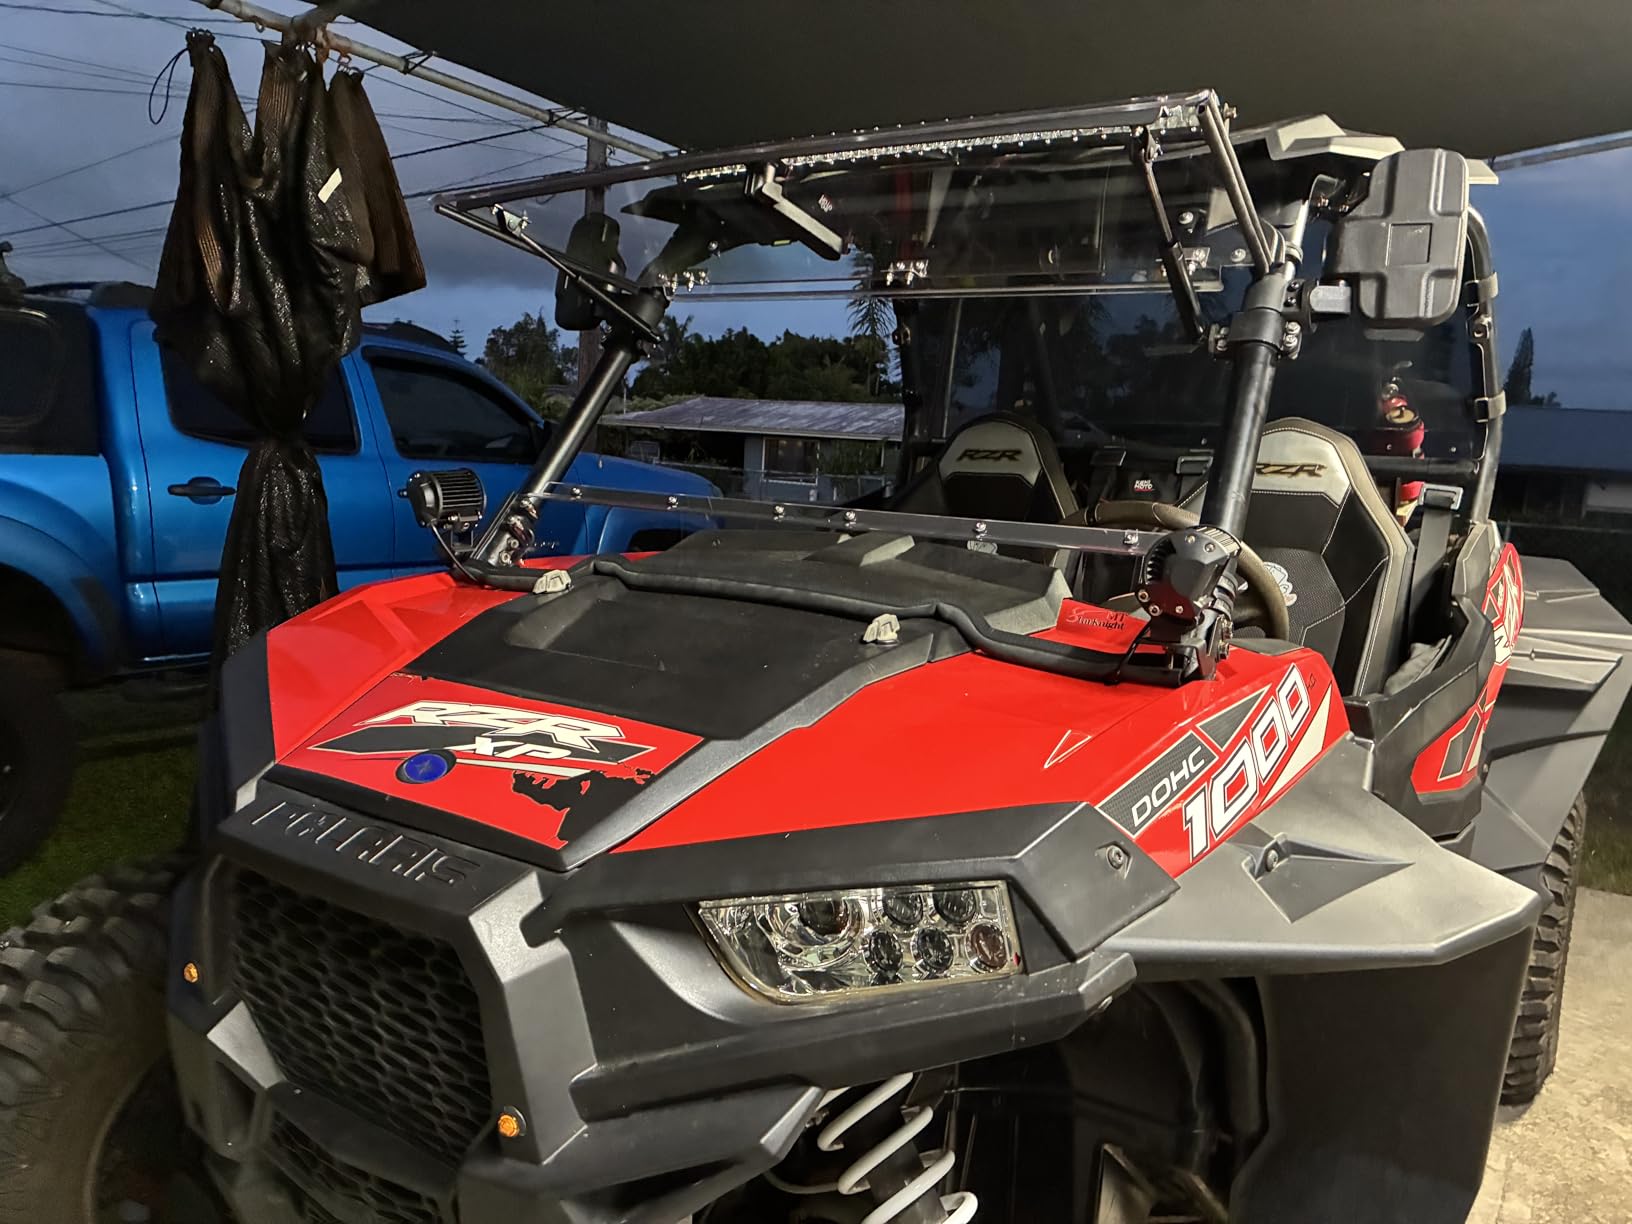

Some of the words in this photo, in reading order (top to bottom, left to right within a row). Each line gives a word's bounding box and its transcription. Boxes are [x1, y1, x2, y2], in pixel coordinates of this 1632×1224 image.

[956, 449, 1023, 461] RZR
[352, 700, 625, 753] RZR
[443, 736, 572, 759] XP
[1131, 745, 1205, 827] DOHC
[1183, 663, 1311, 863] 1000
[251, 801, 481, 886] POLARIS
